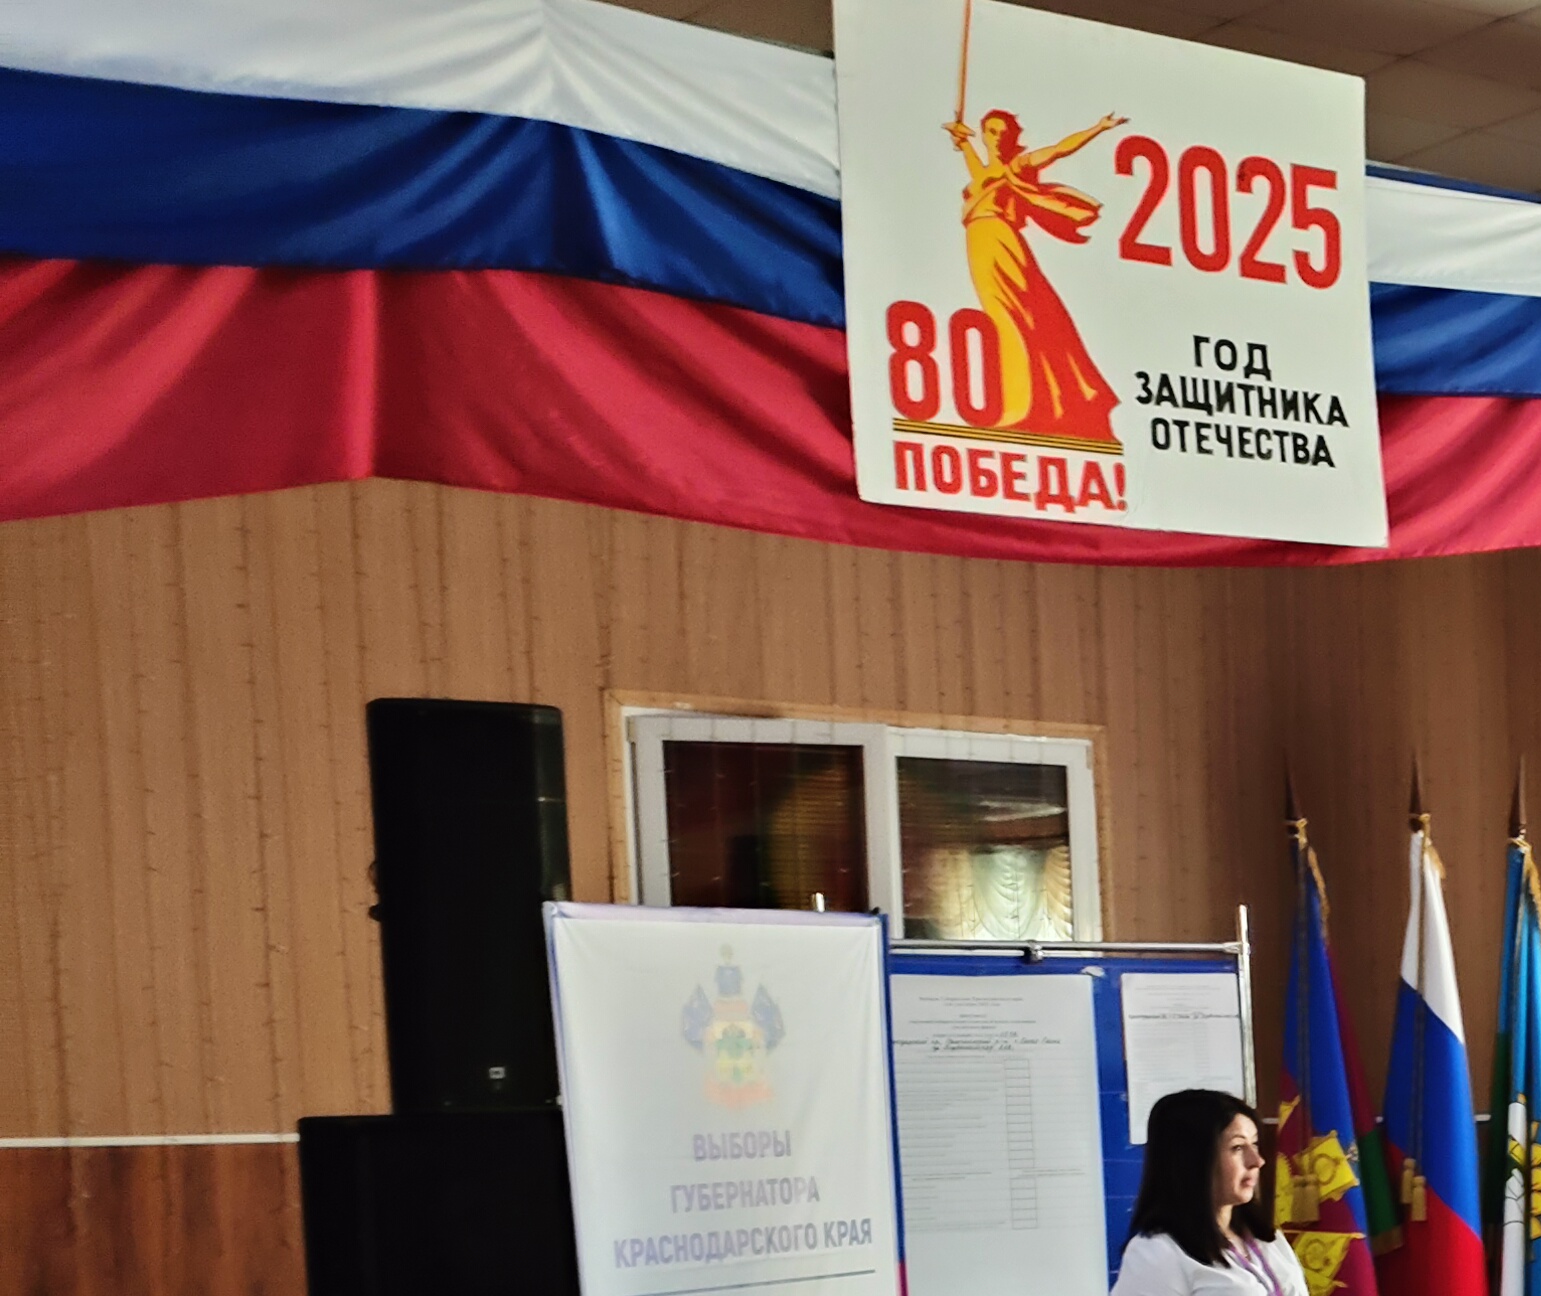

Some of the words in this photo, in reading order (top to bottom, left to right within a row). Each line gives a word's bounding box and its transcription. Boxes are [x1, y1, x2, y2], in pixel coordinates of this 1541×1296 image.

[1114, 135, 1342, 289] 2025
[886, 300, 1003, 429] 80
[1193, 335, 1272, 381] ГОД
[1135, 371, 1350, 428] ЗАЩИТНИКА
[1150, 418, 1336, 468] ОТЕЧЕСТВА
[893, 441, 1127, 513] ПОБЕДА!
[692, 1130, 792, 1162] ВЫБОРЫ
[670, 1176, 820, 1213] ГУБЕРНАТОРА
[614, 1222, 818, 1269] КРАСНОДАРСКОГО
[823, 1218, 873, 1249] КРАЯ
